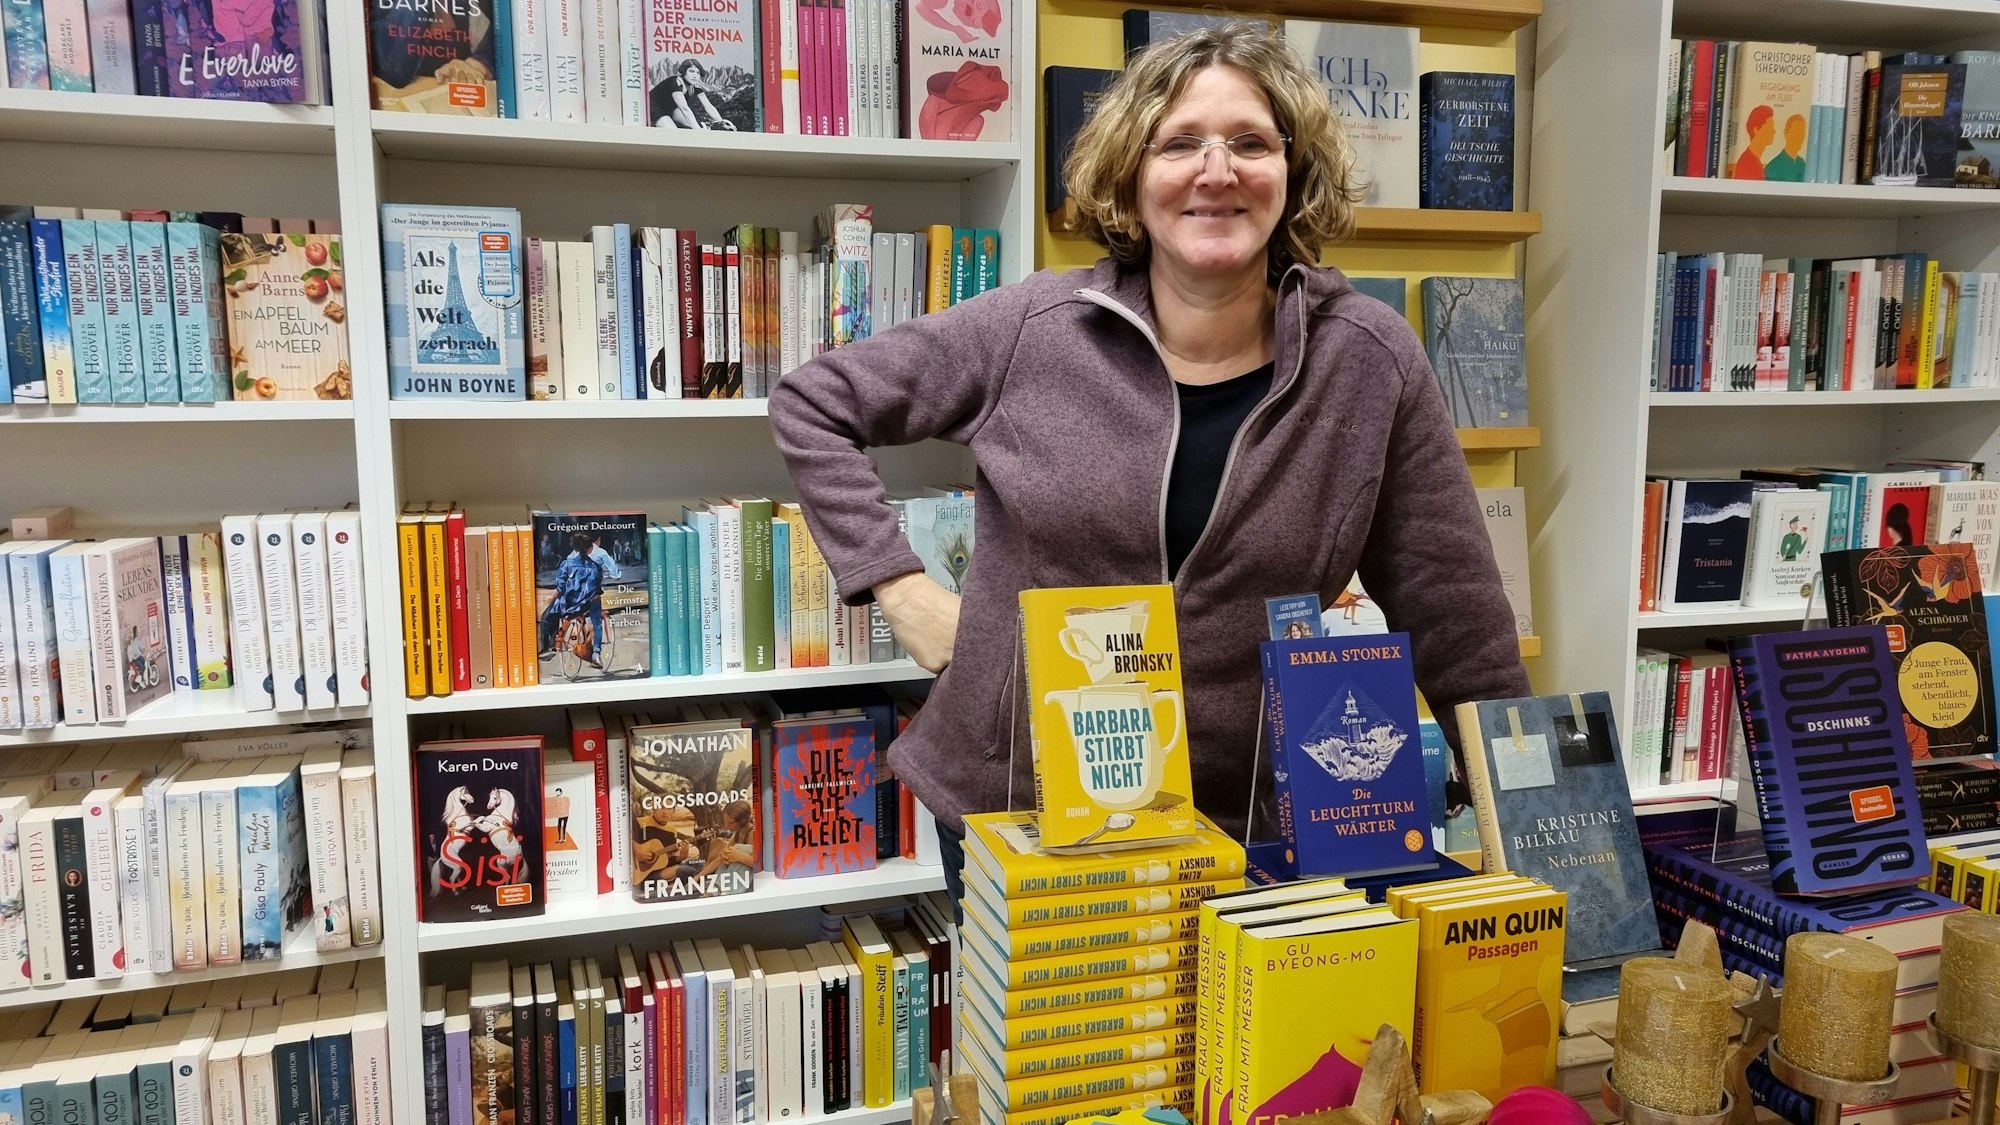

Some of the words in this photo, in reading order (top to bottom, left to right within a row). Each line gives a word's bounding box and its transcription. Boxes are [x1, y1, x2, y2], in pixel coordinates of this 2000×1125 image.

[654, 0, 738, 13] REBELLION
[654, 9, 685, 24] DER
[388, 25, 472, 42] ELIZABETH
[654, 26, 743, 43] ALFONSINA
[407, 45, 457, 59] FINCH
[654, 41, 715, 55] STRADA
[921, 44, 964, 58] MARIA
[968, 46, 1001, 59] MALT
[201, 42, 297, 80] Everlove
[1754, 51, 1811, 64] CHRISTOPHER
[524, 53, 533, 92] VICKI
[535, 53, 544, 95] BAUM
[1755, 64, 1808, 76] ISHERWOOD
[242, 79, 269, 89] TANYA
[271, 77, 298, 87] BYRNE
[1443, 78, 1479, 87] MICHAEL
[1481, 78, 1506, 88] WILDT
[1760, 82, 1801, 93] BEGEGNUNG
[1329, 88, 1410, 119] ENKE
[1767, 93, 1777, 102] AM
[1439, 100, 1509, 112] ZERBORSTENE
[1459, 115, 1492, 128] ZEIT
[1450, 141, 1499, 151] DEUTSCHE
[1444, 154, 1505, 163] GESCHICHTE
[842, 225, 866, 233] JOSHUA
[843, 234, 866, 242] COHEN
[682, 238, 690, 262] ALEX
[840, 246, 868, 256] WITZ
[68, 253, 79, 269] EIN
[412, 250, 445, 268] Als
[71, 270, 82, 296] NOCH
[88, 261, 99, 302] EINZIGES
[259, 270, 300, 284] Anne
[597, 270, 606, 284] DIE
[683, 264, 691, 292] CAPUS
[261, 283, 305, 296] Barns
[415, 281, 444, 295] die
[73, 297, 84, 316] NUR
[234, 309, 253, 320] EIN
[254, 305, 306, 321] APFEL
[416, 307, 464, 325] Welt
[685, 297, 693, 339] SUSANNA
[280, 321, 329, 336] BAUM
[599, 318, 608, 349] HELENE
[609, 311, 617, 356] BUKOWSKI
[85, 322, 100, 375] HOOVER
[256, 338, 274, 349] AM
[275, 337, 321, 353] MEER
[418, 335, 497, 351] zerbrach
[1484, 342, 1516, 350] HAIKU
[404, 378, 452, 393] JOHN
[459, 378, 516, 393] BOYNE
[1946, 491, 1977, 501] MARIANA
[1980, 488, 1999, 500] WAS
[935, 504, 958, 521] Fang
[1952, 503, 1968, 512] LEKY
[1976, 504, 1997, 515] MAN
[548, 522, 589, 533] Grégoire
[591, 522, 635, 531] Delacourt
[1976, 519, 1992, 530] VON
[1973, 534, 1992, 545] HIER
[755, 543, 763, 566] letzten
[1694, 557, 1733, 568] Tristania
[710, 552, 718, 577] Vogel
[122, 565, 153, 586] LEBENS
[117, 580, 160, 603] SEKUNDEN
[617, 585, 634, 593] Die
[710, 580, 718, 597] der
[620, 607, 641, 616] aller
[703, 597, 711, 629] Despret
[835, 593, 843, 624] Didion
[1908, 607, 1940, 617] ALENA
[99, 572, 114, 669] LEBENSSEKUNDEN
[609, 618, 641, 627] Farben
[1918, 614, 1969, 625] SCHRÖDER
[834, 627, 844, 649] Joan
[1105, 633, 1143, 652] ALINA
[704, 631, 712, 668] Vinciane
[1290, 651, 1337, 665] EMMA
[1342, 646, 1402, 661] STONEX
[1786, 650, 1820, 661] FATMA
[1823, 646, 1867, 658] AYDEMIR
[1114, 653, 1173, 673] BRONSKY
[1914, 658, 1943, 668] Junge
[1945, 658, 1968, 668] Frau,
[1918, 670, 1933, 678] am
[1936, 668, 1968, 678] Fenster
[1912, 680, 1949, 690] stehend,
[1921, 690, 1971, 700] Abendlicht,
[1939, 700, 1967, 710] blaues
[1073, 707, 1152, 736] BARBARA
[1340, 715, 1367, 725] Roman
[1807, 716, 1871, 732] DSCHINNS
[1931, 711, 1955, 721] Kleid
[238, 744, 254, 752] EVA
[256, 741, 289, 751] VÖLLER
[643, 734, 748, 757] JONATHAN
[1084, 735, 1144, 763] STIRBT
[438, 760, 478, 773] Karen
[482, 758, 518, 770] Duve
[810, 748, 844, 776] DIE
[1091, 762, 1142, 790] NICHT
[642, 789, 748, 811] CROSSROADS
[1352, 789, 1371, 800] Die
[1860, 795, 1883, 804] SPIEGEL
[811, 795, 845, 823] DIE
[1066, 807, 1090, 817] ROMAN
[1311, 801, 1415, 821] LEUCHTTURM
[1860, 804, 1887, 813] Bestseller
[1335, 820, 1396, 836] WÄRTER
[1537, 809, 1621, 832] KRISTINE
[793, 817, 863, 849] BLEIBT
[1514, 830, 1580, 850] BILKAU
[32, 830, 42, 883] FRIDA
[439, 835, 523, 888] Sisi
[1179, 857, 1215, 870] BRONSKY
[1547, 851, 1615, 869] Nebenan
[255, 861, 267, 893] Pauly
[1050, 874, 1082, 888] STIRBT
[1086, 870, 1126, 885] BARBARA
[1179, 871, 1201, 880] ALINA
[644, 871, 750, 899] FRANZEN
[1019, 877, 1047, 892] NICHT
[256, 896, 266, 920] Gisa
[1726, 900, 1774, 926] DSCHINNS
[1444, 916, 1497, 945] ANN
[1504, 906, 1564, 936] QUIN
[1286, 944, 1311, 956] GU
[1467, 938, 1538, 961] Passagen
[1267, 948, 1376, 972] BYEONG-MO
[1242, 965, 1253, 1039] MESSER
[487, 1010, 495, 1063] CROSSROADS
[897, 1001, 907, 1070] PANDATAGE
[629, 1039, 642, 1071] kork
[1241, 1045, 1251, 1074] MIT
[1238, 1079, 1251, 1114] FRAU
